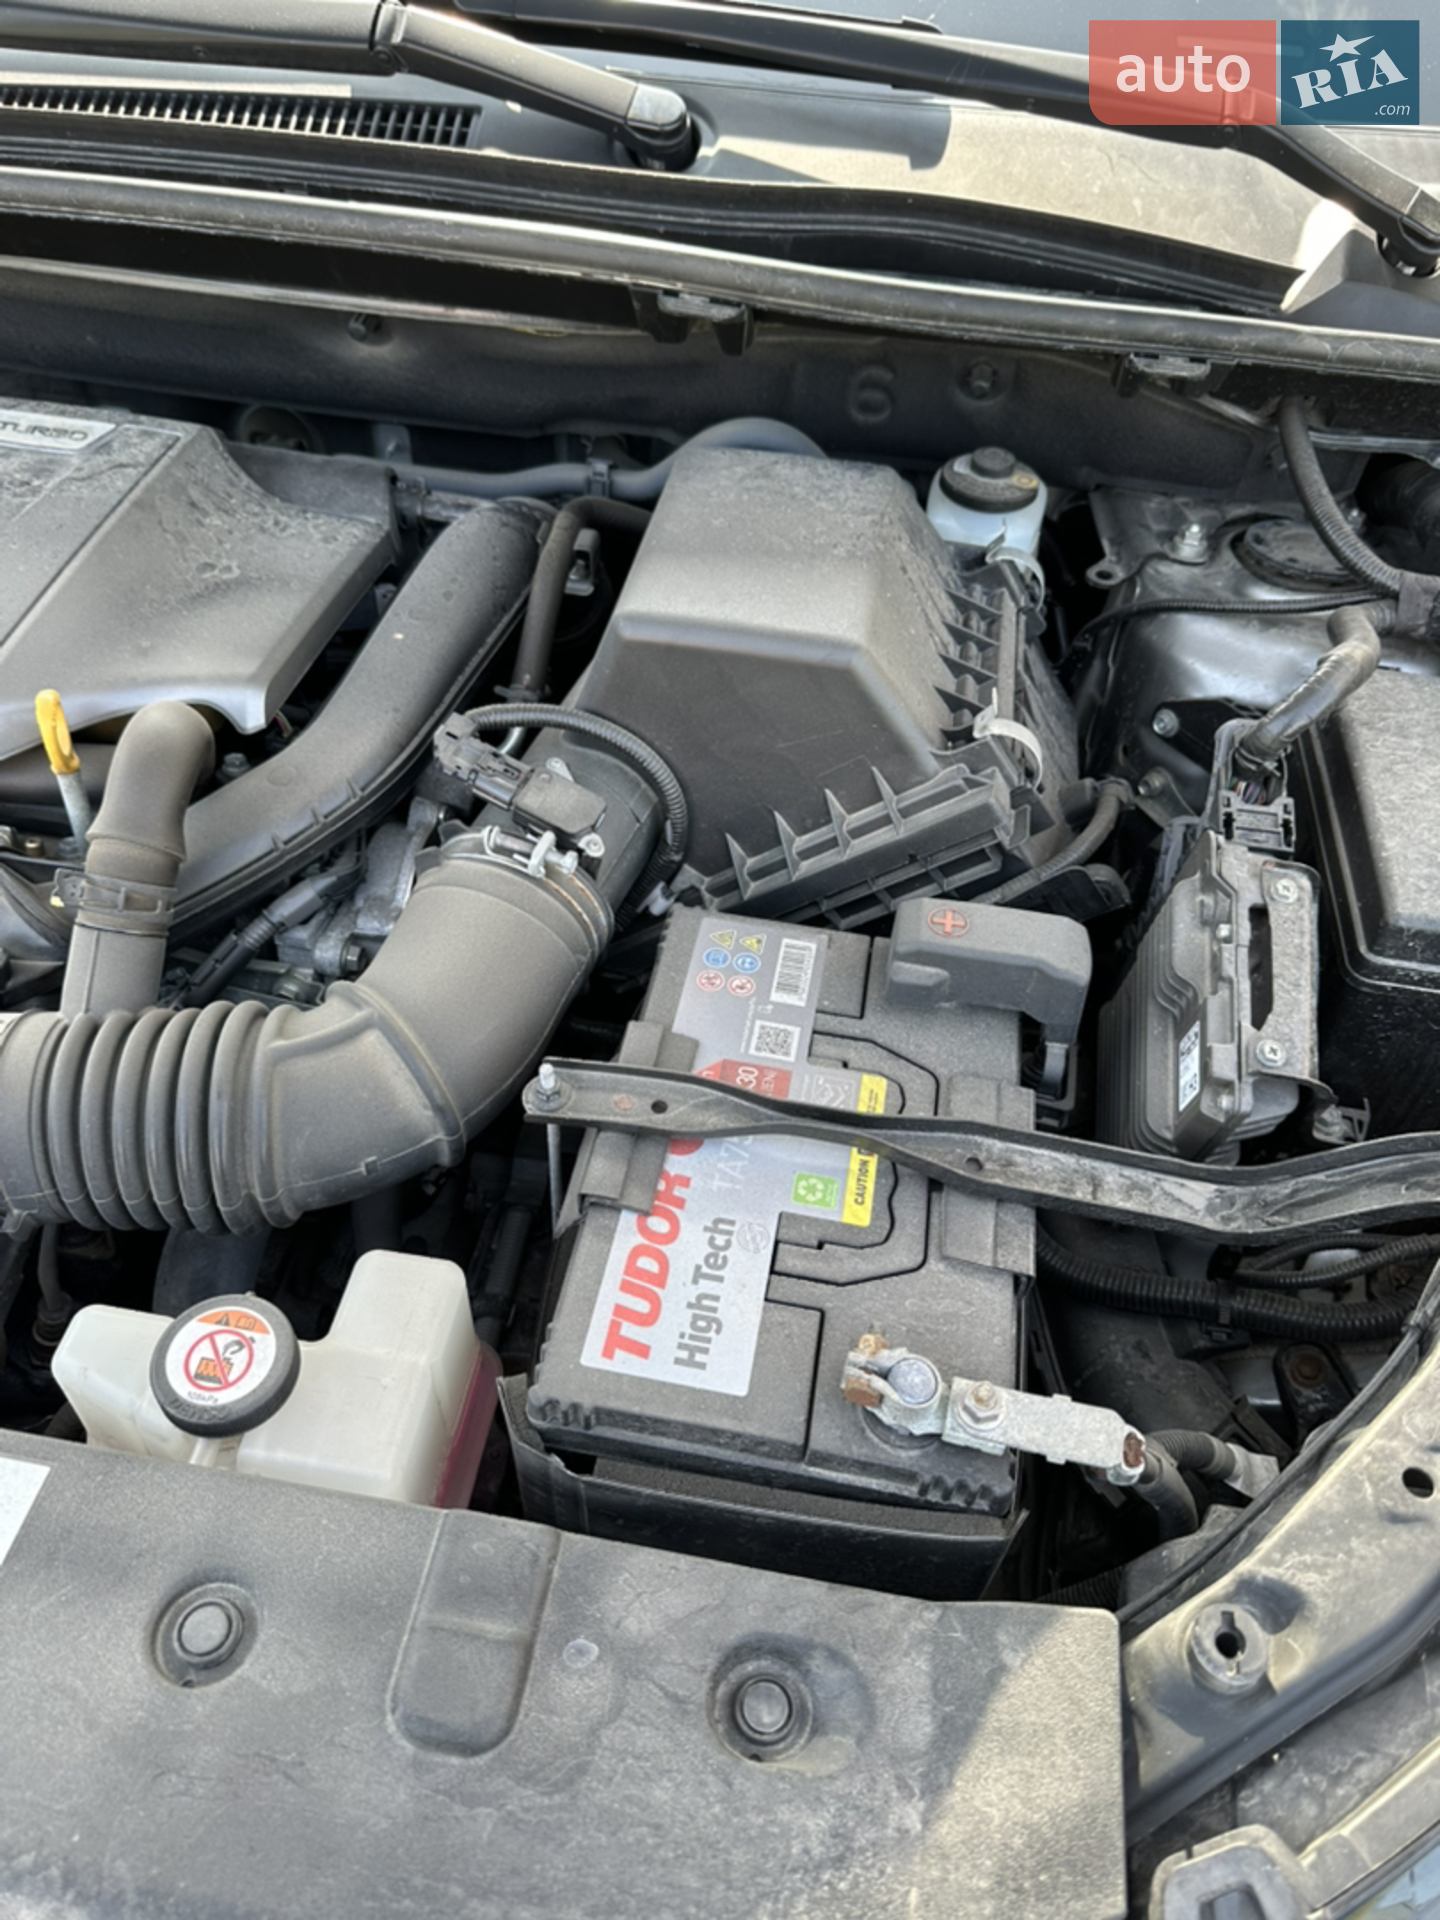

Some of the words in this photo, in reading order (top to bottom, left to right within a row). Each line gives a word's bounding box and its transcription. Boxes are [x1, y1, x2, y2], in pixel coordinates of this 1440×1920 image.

[854, 1159, 870, 1206] CAUTION
[602, 1169, 692, 1362] TUDOR
[691, 1216, 736, 1285] Tech
[673, 1291, 723, 1371] High
